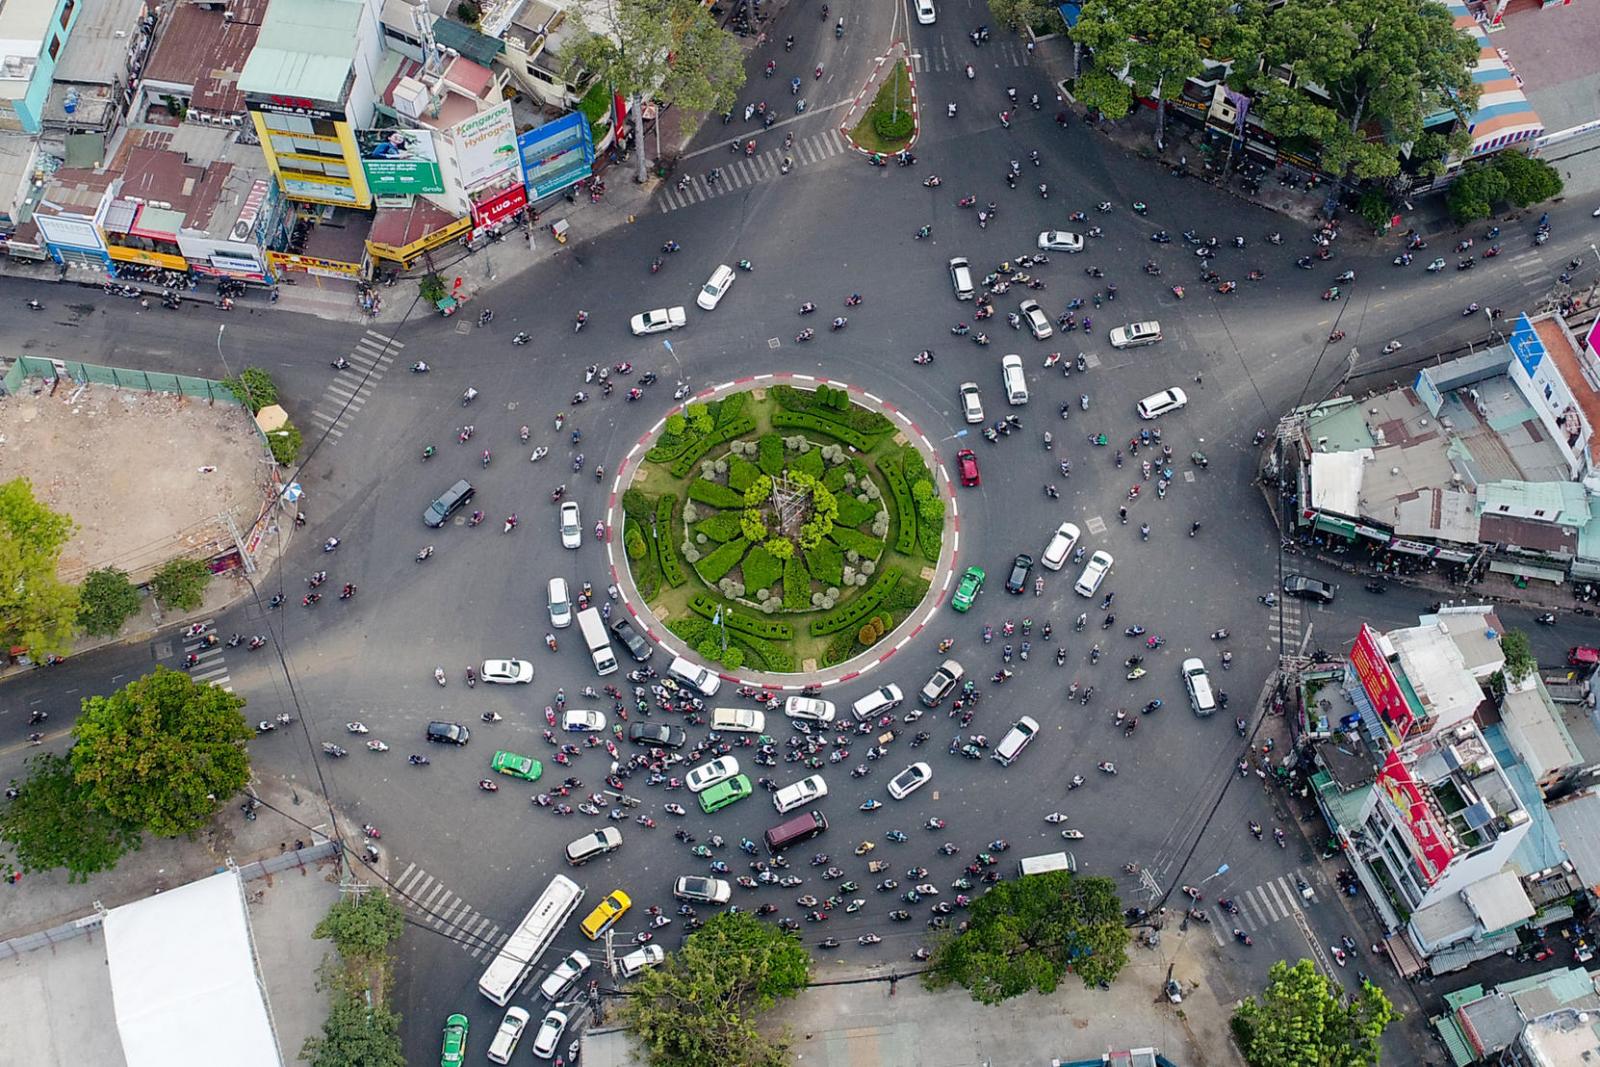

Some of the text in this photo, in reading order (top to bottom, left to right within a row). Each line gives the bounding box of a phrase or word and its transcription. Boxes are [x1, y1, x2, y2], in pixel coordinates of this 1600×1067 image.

[260, 103, 293, 112] fitness
[457, 107, 508, 134] Kangaroo
[464, 122, 511, 149] Hydrogen
